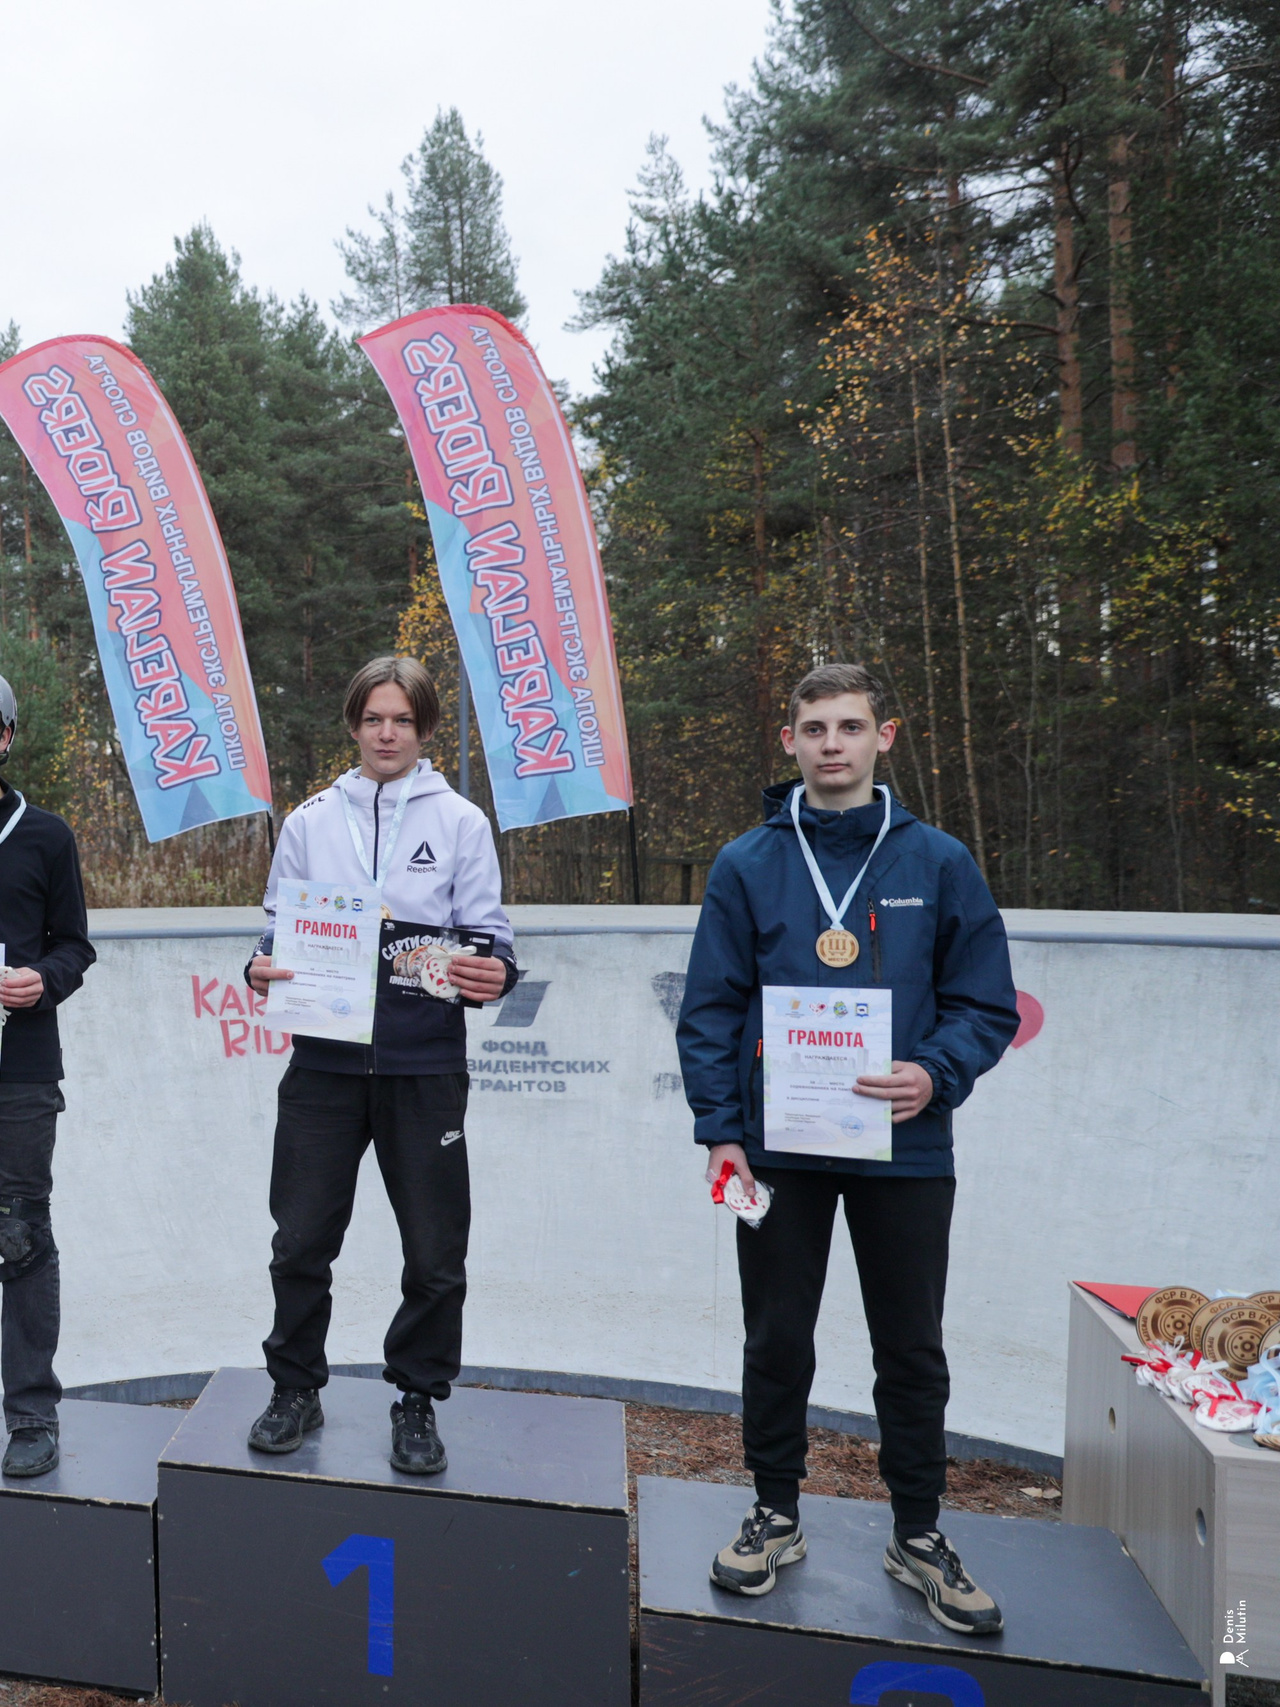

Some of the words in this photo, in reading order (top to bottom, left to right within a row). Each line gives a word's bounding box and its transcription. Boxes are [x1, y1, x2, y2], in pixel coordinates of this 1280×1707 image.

[407, 865, 437, 873] Reebok
[888, 897, 923, 905] Columbia
[295, 919, 357, 940] ГРАМОТА
[788, 1030, 864, 1047] ГРАМОТА
[482, 1040, 548, 1056] ФОНД
[469, 1078, 567, 1093] ГРАНТОВ
[1154, 1291, 1176, 1304] ФСР
[1189, 1292, 1204, 1305] РК
[1210, 1301, 1233, 1314] ФСР
[1222, 1311, 1245, 1324] ФСР
[1248, 1311, 1256, 1319] В
[1258, 1313, 1273, 1326] РК
[321, 1533, 395, 1678] 1
